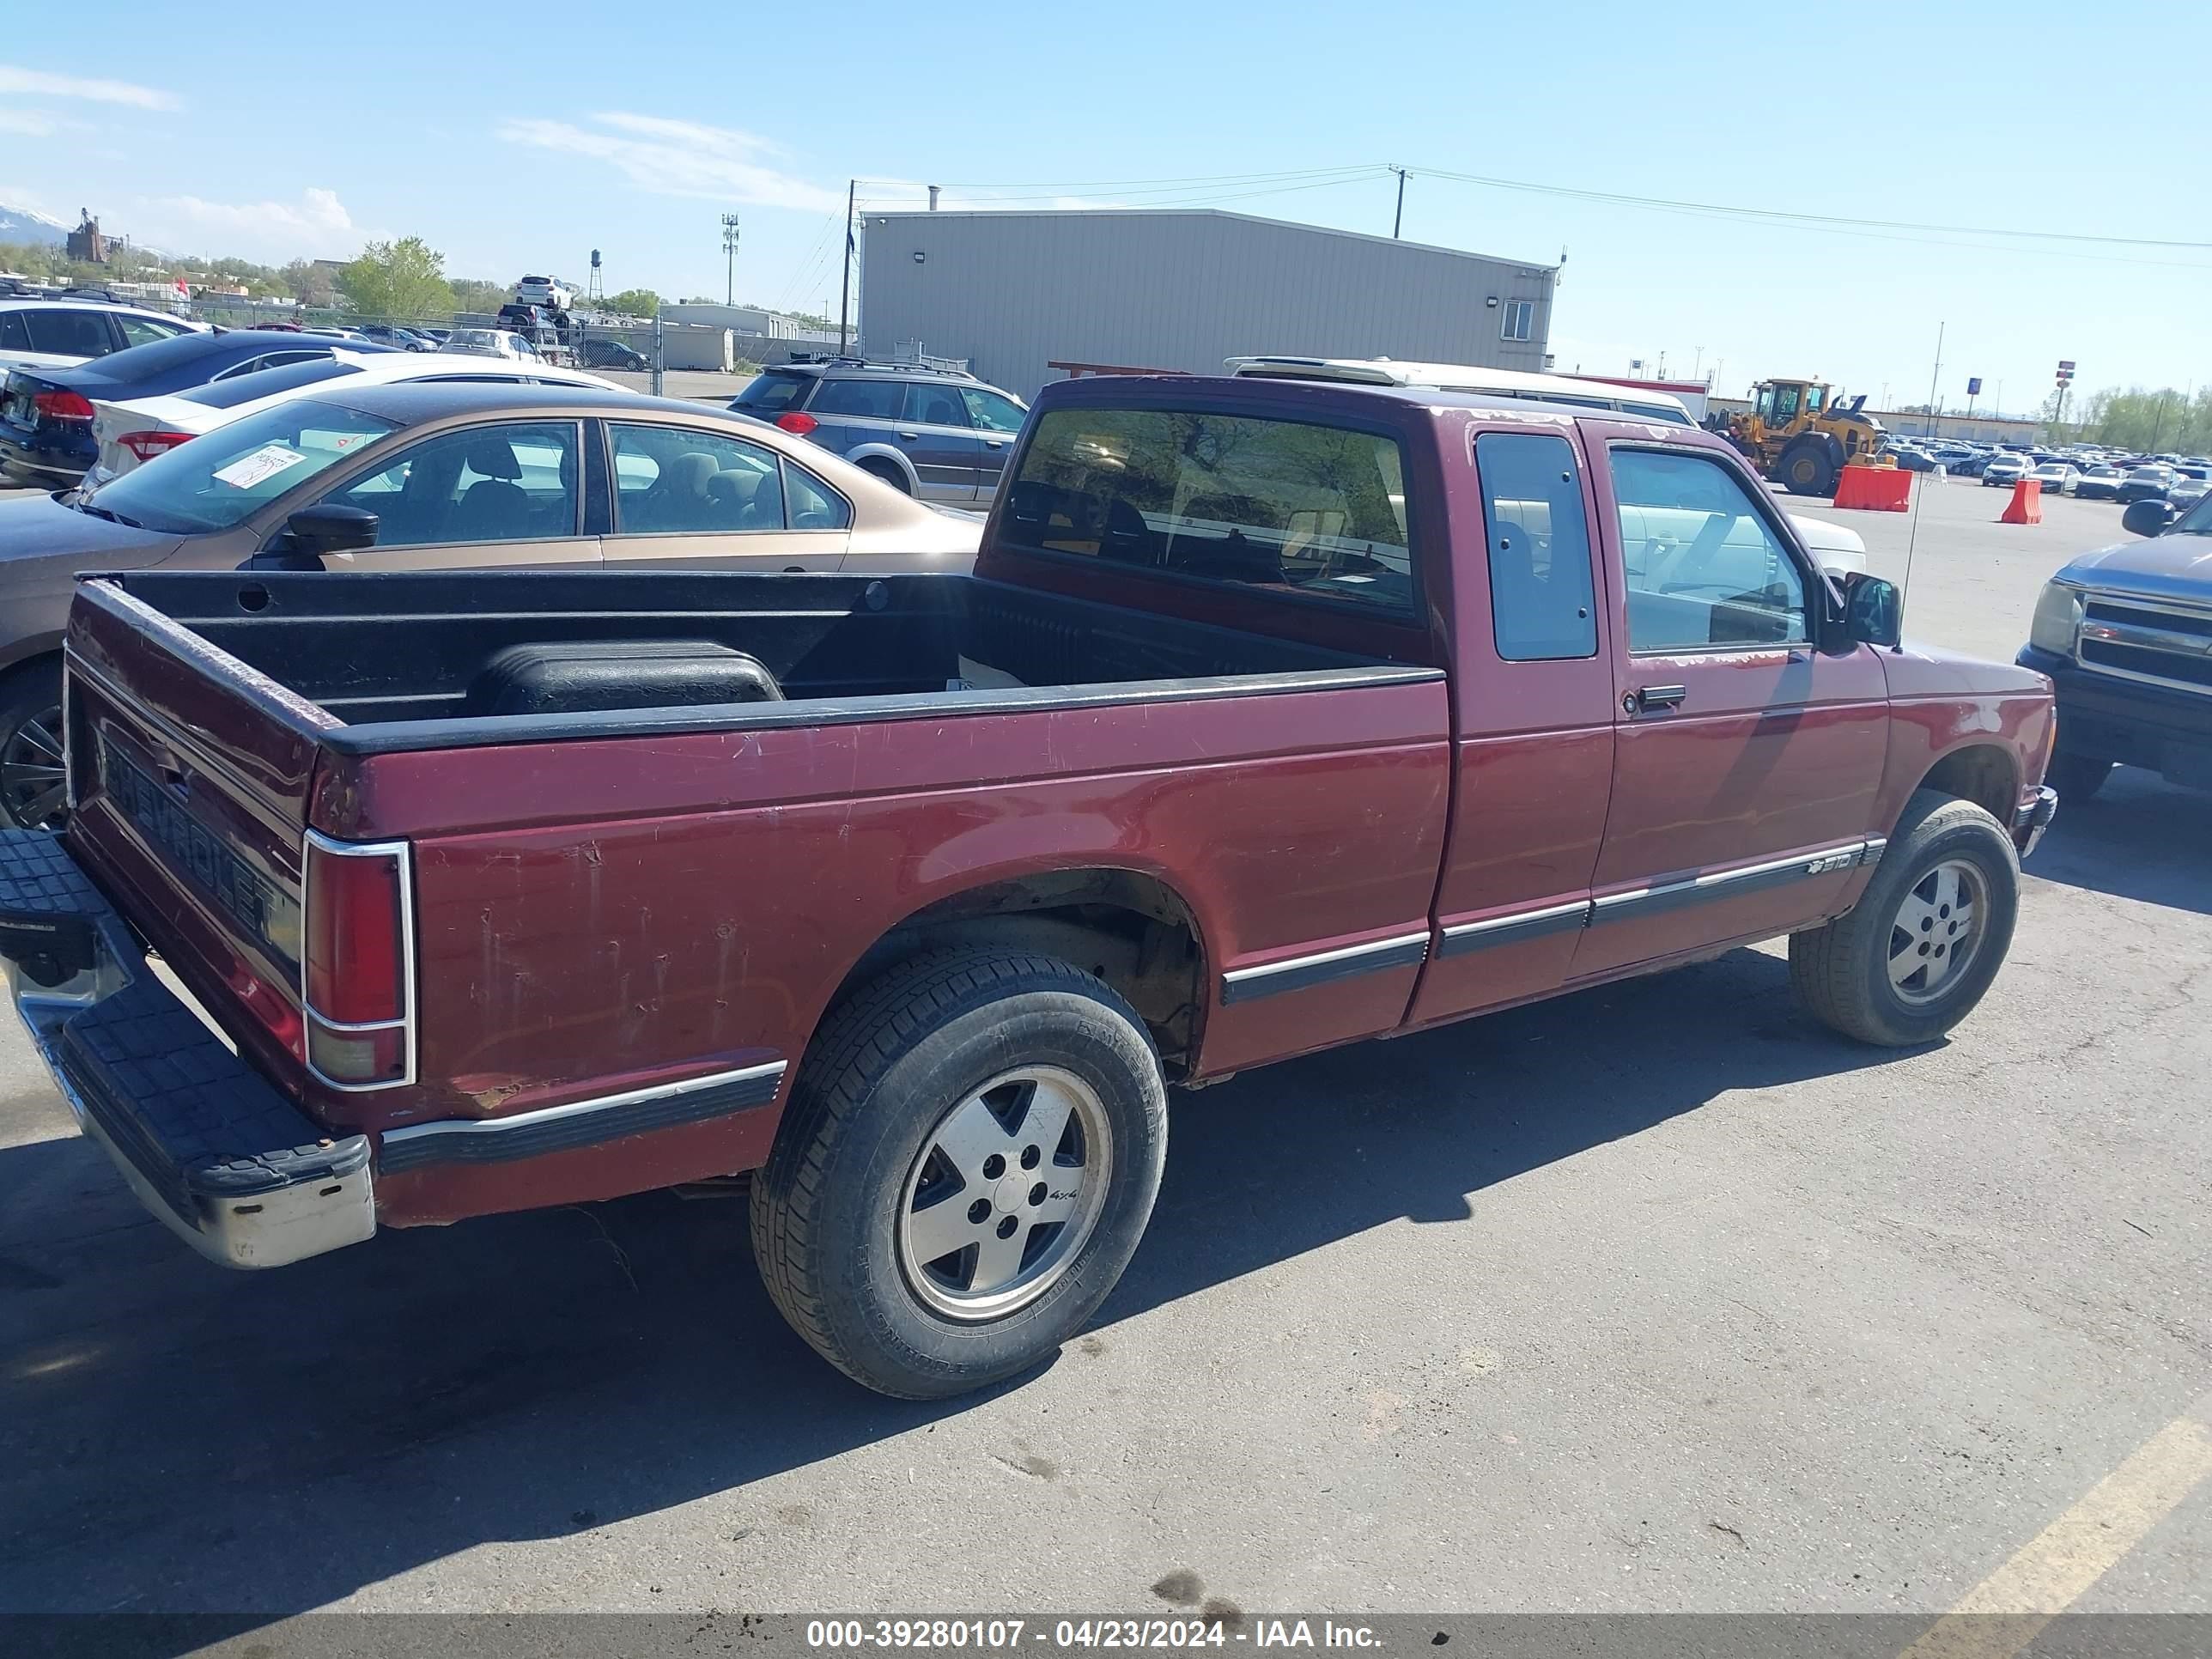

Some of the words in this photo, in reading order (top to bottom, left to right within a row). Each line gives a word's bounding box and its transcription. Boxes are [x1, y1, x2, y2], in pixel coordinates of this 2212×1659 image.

[105, 744, 277, 945] CHEVROLET
[1049, 1189, 1078, 1200] 4x4
[876, 1311, 972, 1374] TOURING
